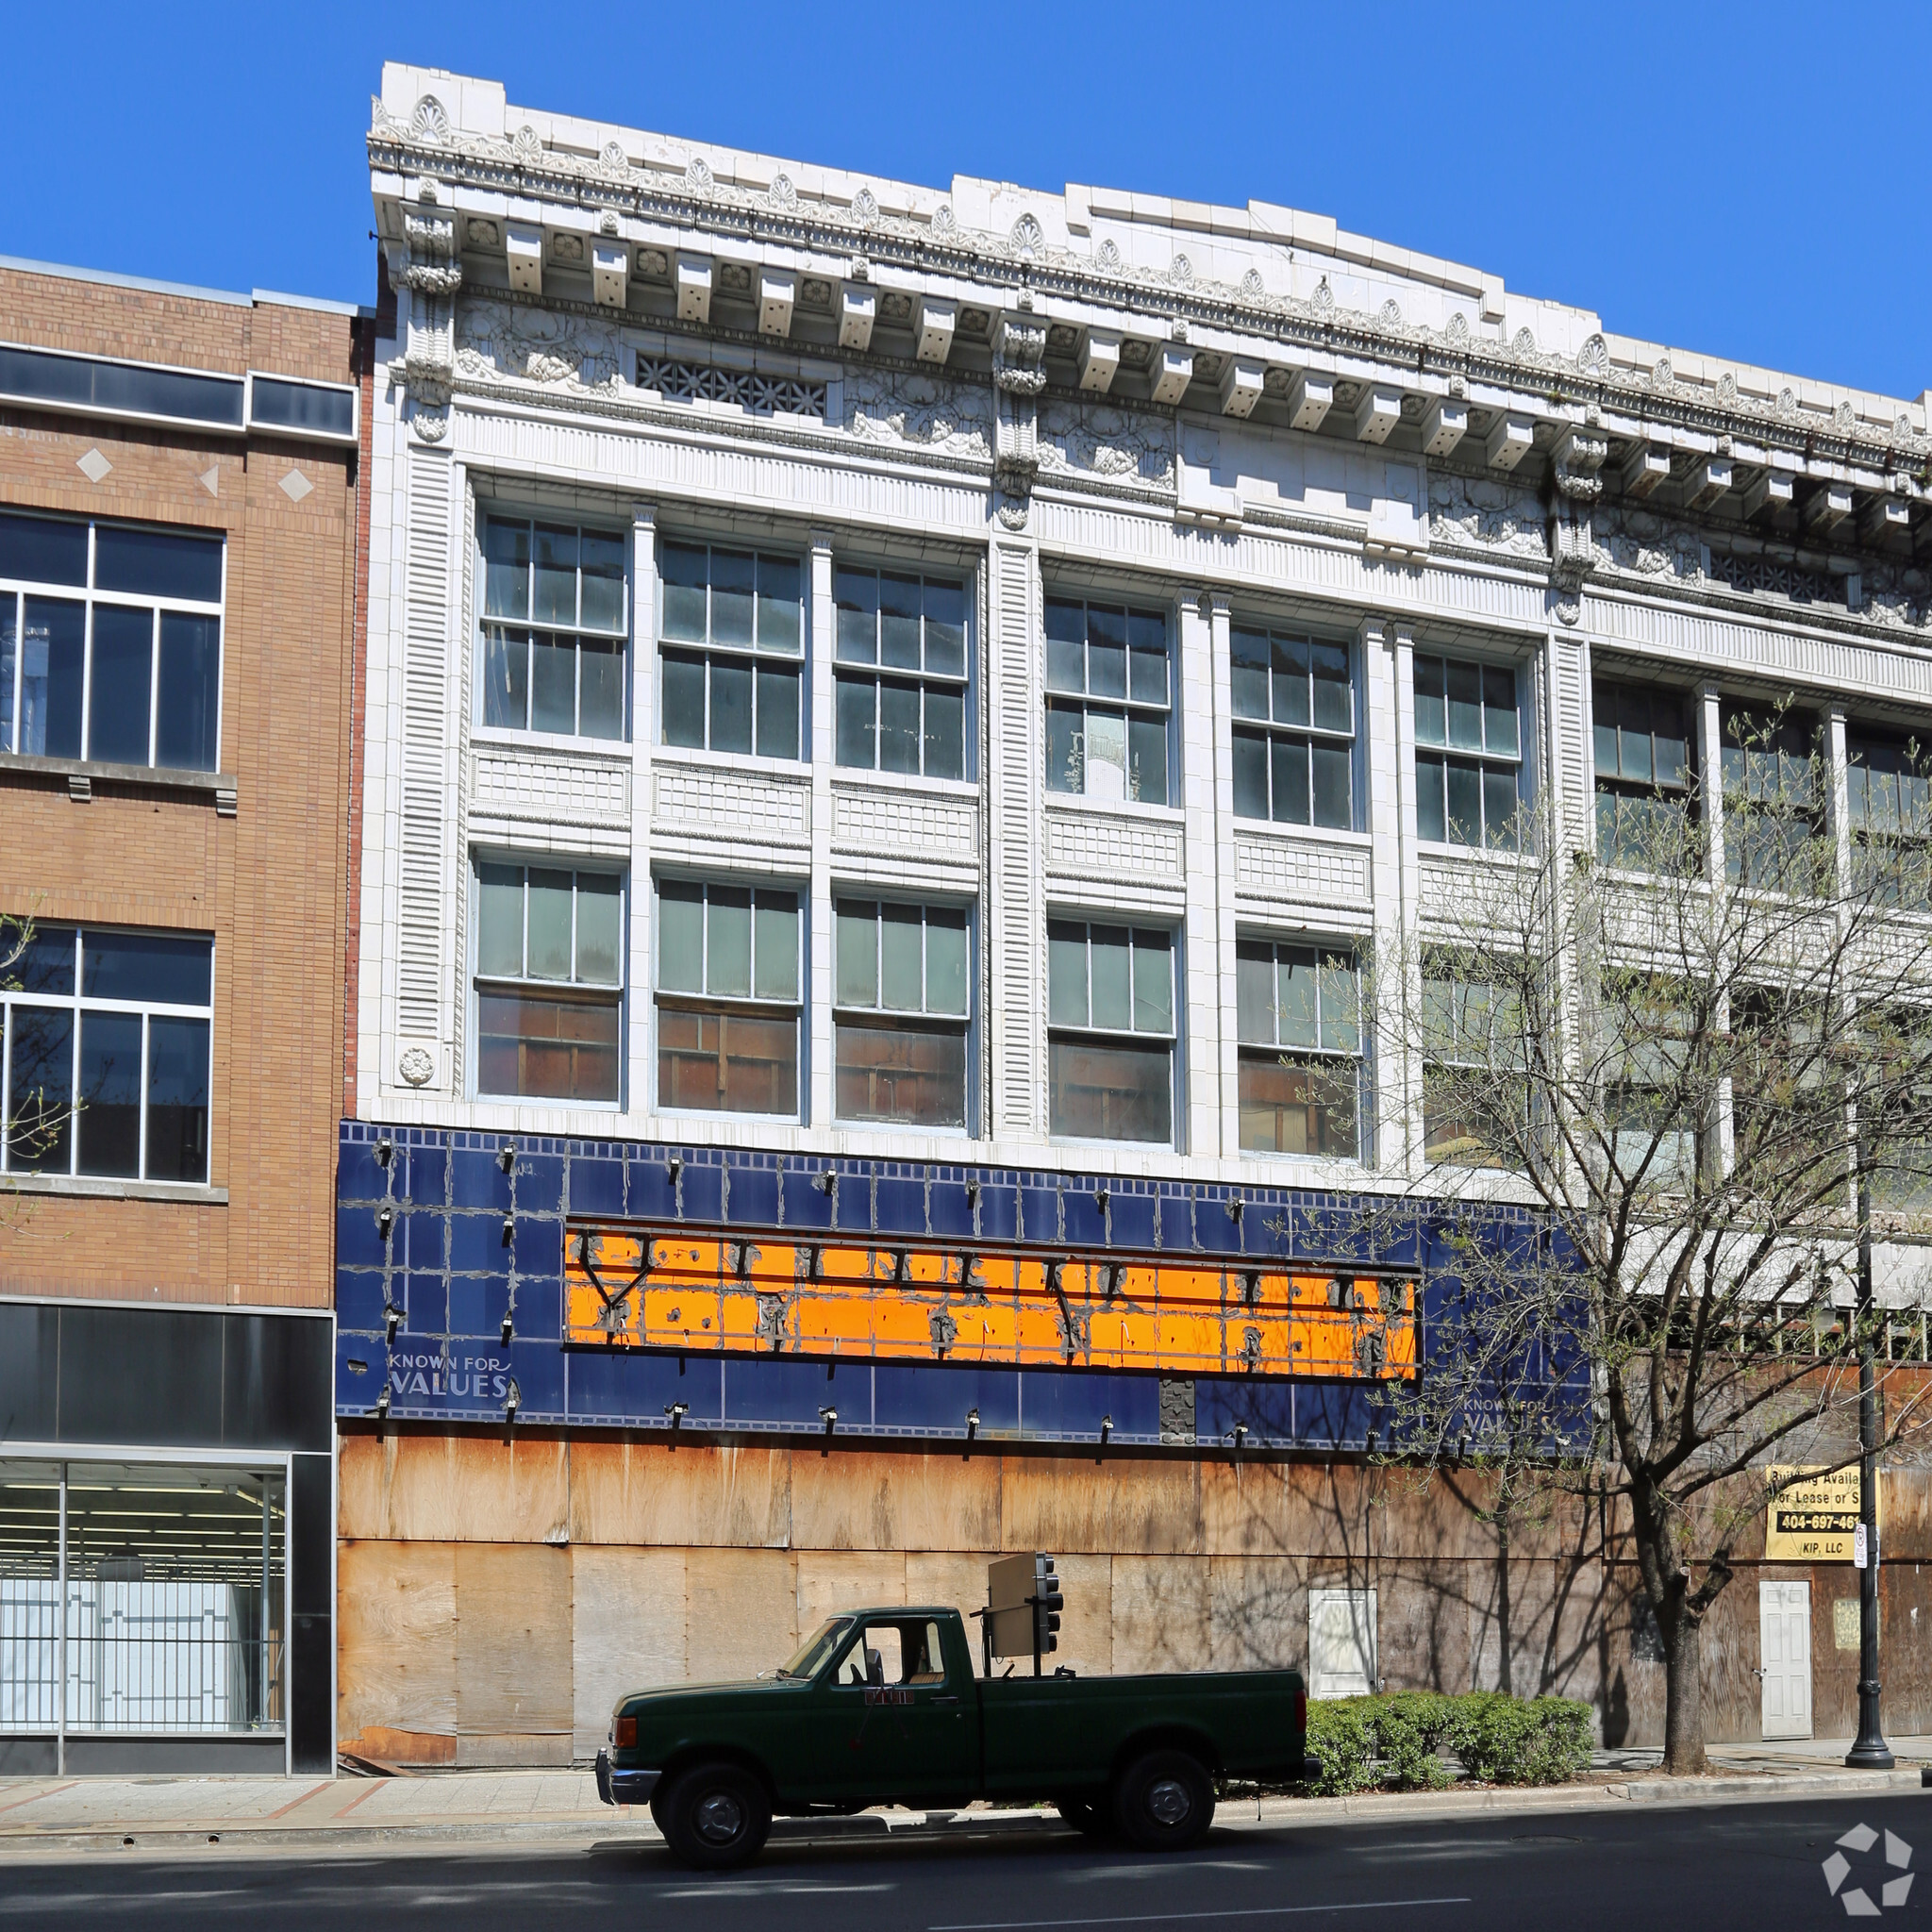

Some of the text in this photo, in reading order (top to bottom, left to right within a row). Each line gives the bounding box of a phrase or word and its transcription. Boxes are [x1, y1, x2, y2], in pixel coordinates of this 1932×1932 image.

[389, 1354, 511, 1372] KNOWN FOR
[390, 1371, 508, 1398] VALUES
[1796, 1491, 1829, 1504] Lease
[1836, 1494, 1846, 1504] or
[1803, 1542, 1842, 1555] KIP, LLC
